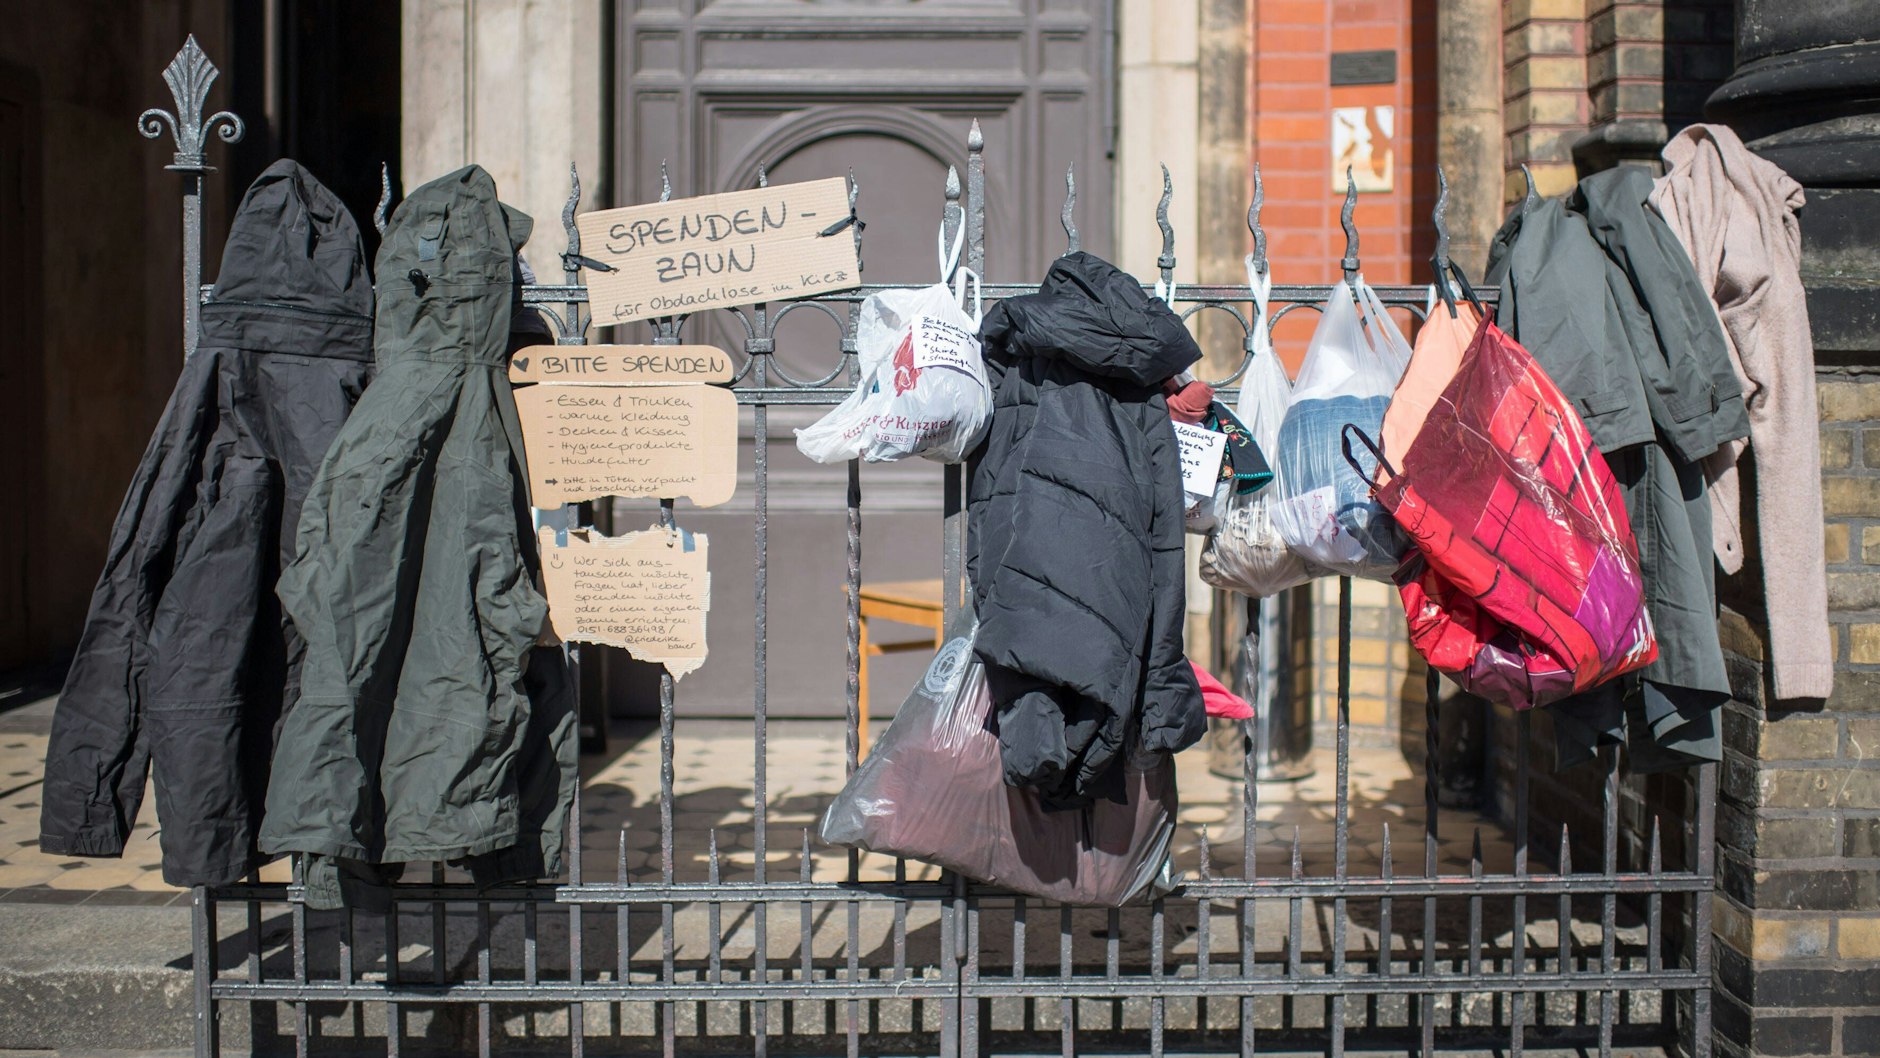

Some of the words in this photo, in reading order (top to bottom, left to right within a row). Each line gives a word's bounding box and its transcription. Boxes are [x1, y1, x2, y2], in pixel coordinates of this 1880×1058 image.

[656, 244, 755, 283] ZAUN
[650, 286, 764, 311] Obdachlose
[772, 282, 793, 293] im
[800, 270, 848, 287] Kiez
[931, 333, 960, 346] Jeans
[542, 355, 608, 374] BITTE
[622, 355, 724, 374] SPENDEN
[557, 394, 606, 407] Essen
[629, 396, 693, 408] Trinken
[559, 413, 613, 422] warme
[621, 411, 690, 426] Kleidung
[559, 427, 617, 437] Decken
[634, 427, 686, 437] Kissen
[561, 441, 694, 456] Hygieneprodukte
[561, 456, 651, 469] Hundefutter
[564, 476, 584, 485] bitte
[641, 475, 696, 487] verpackt
[564, 485, 585, 493] und
[589, 485, 660, 494] beschriftet
[574, 555, 597, 566] Wer
[602, 556, 631, 568] sich
[637, 560, 673, 568] aus-
[574, 570, 634, 578] tauschen
[621, 581, 648, 592] hat,
[652, 582, 688, 590] lieber
[574, 594, 637, 602] spenden
[645, 593, 693, 601] möchte
[575, 605, 602, 614] oder
[609, 605, 646, 613] einen
[652, 605, 701, 614] eigenen
[576, 616, 619, 624] Zaun
[668, 642, 696, 650] bauer
